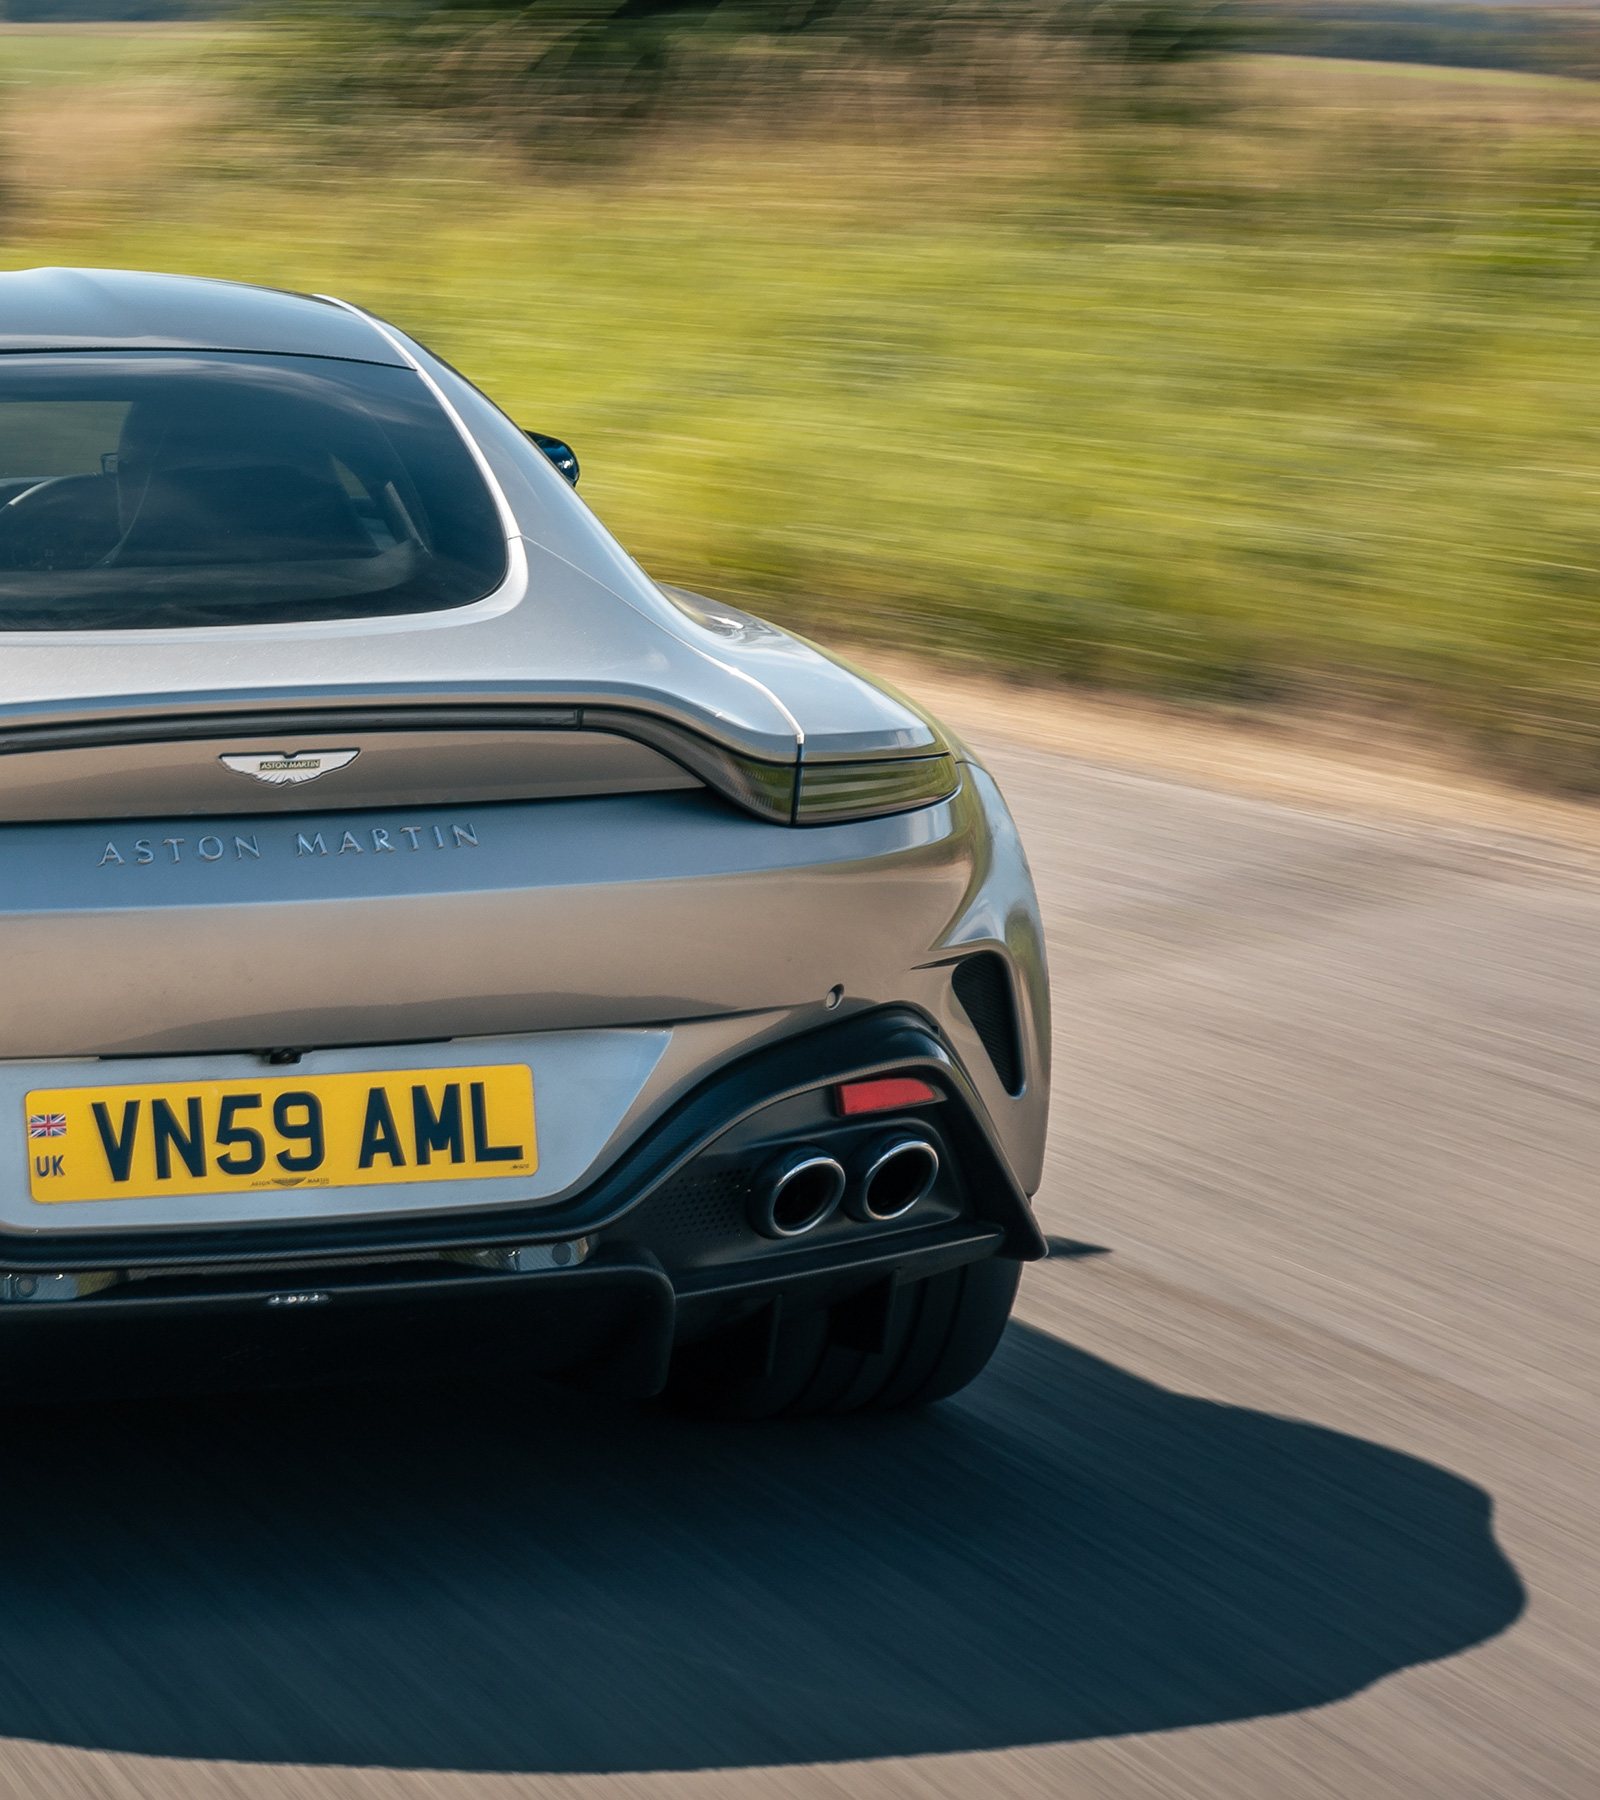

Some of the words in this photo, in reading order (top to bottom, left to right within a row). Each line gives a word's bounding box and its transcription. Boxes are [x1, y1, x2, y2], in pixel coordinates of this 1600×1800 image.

[261, 761, 287, 769] ASTON
[288, 760, 319, 769] MARTIN
[98, 834, 261, 866] ASTON
[296, 822, 480, 857] MARTIN
[91, 1091, 325, 1182] VN59
[358, 1082, 524, 1169] AML
[36, 1154, 66, 1177] UK
